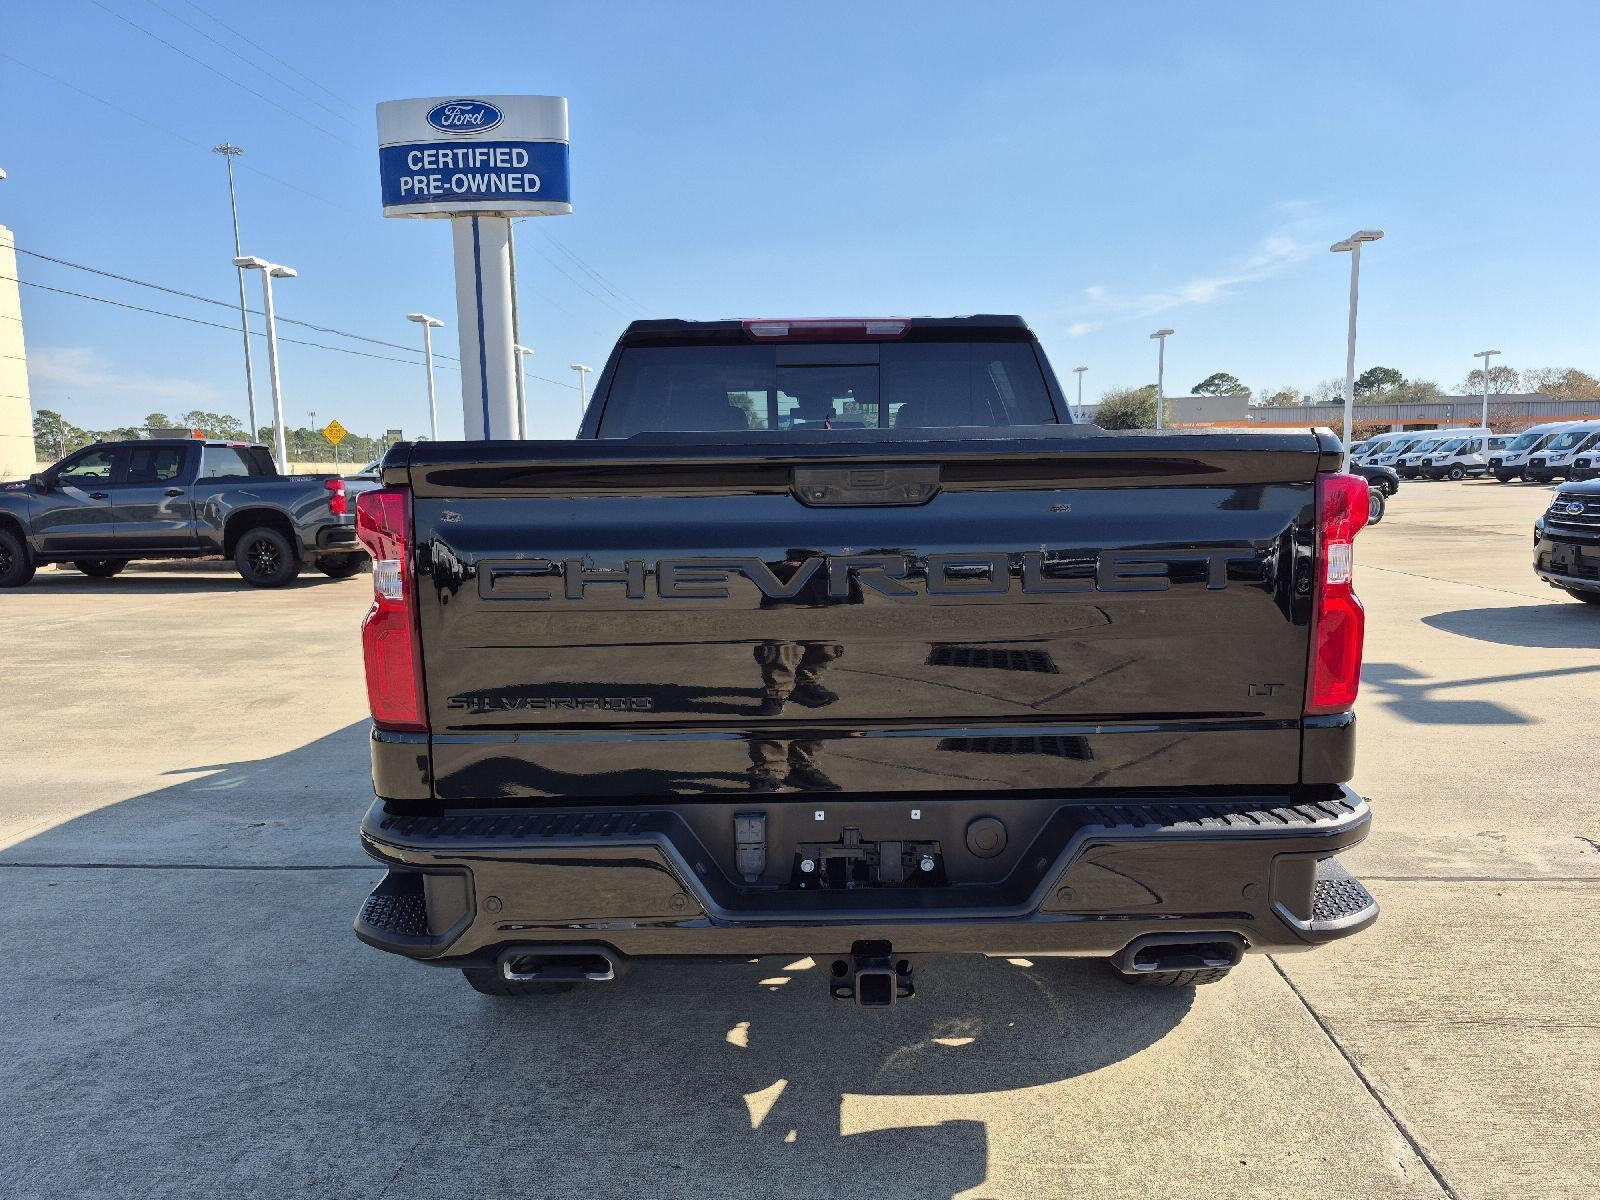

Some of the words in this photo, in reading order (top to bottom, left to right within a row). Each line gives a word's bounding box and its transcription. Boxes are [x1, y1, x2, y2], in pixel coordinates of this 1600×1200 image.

[441, 104, 485, 126] Ford
[407, 148, 529, 170] CERTIFIED
[400, 173, 541, 195] PRE-OWNED
[478, 548, 1255, 600] CHEVROLET
[1248, 683, 1285, 697] LT
[447, 697, 652, 710] SILVERADO
